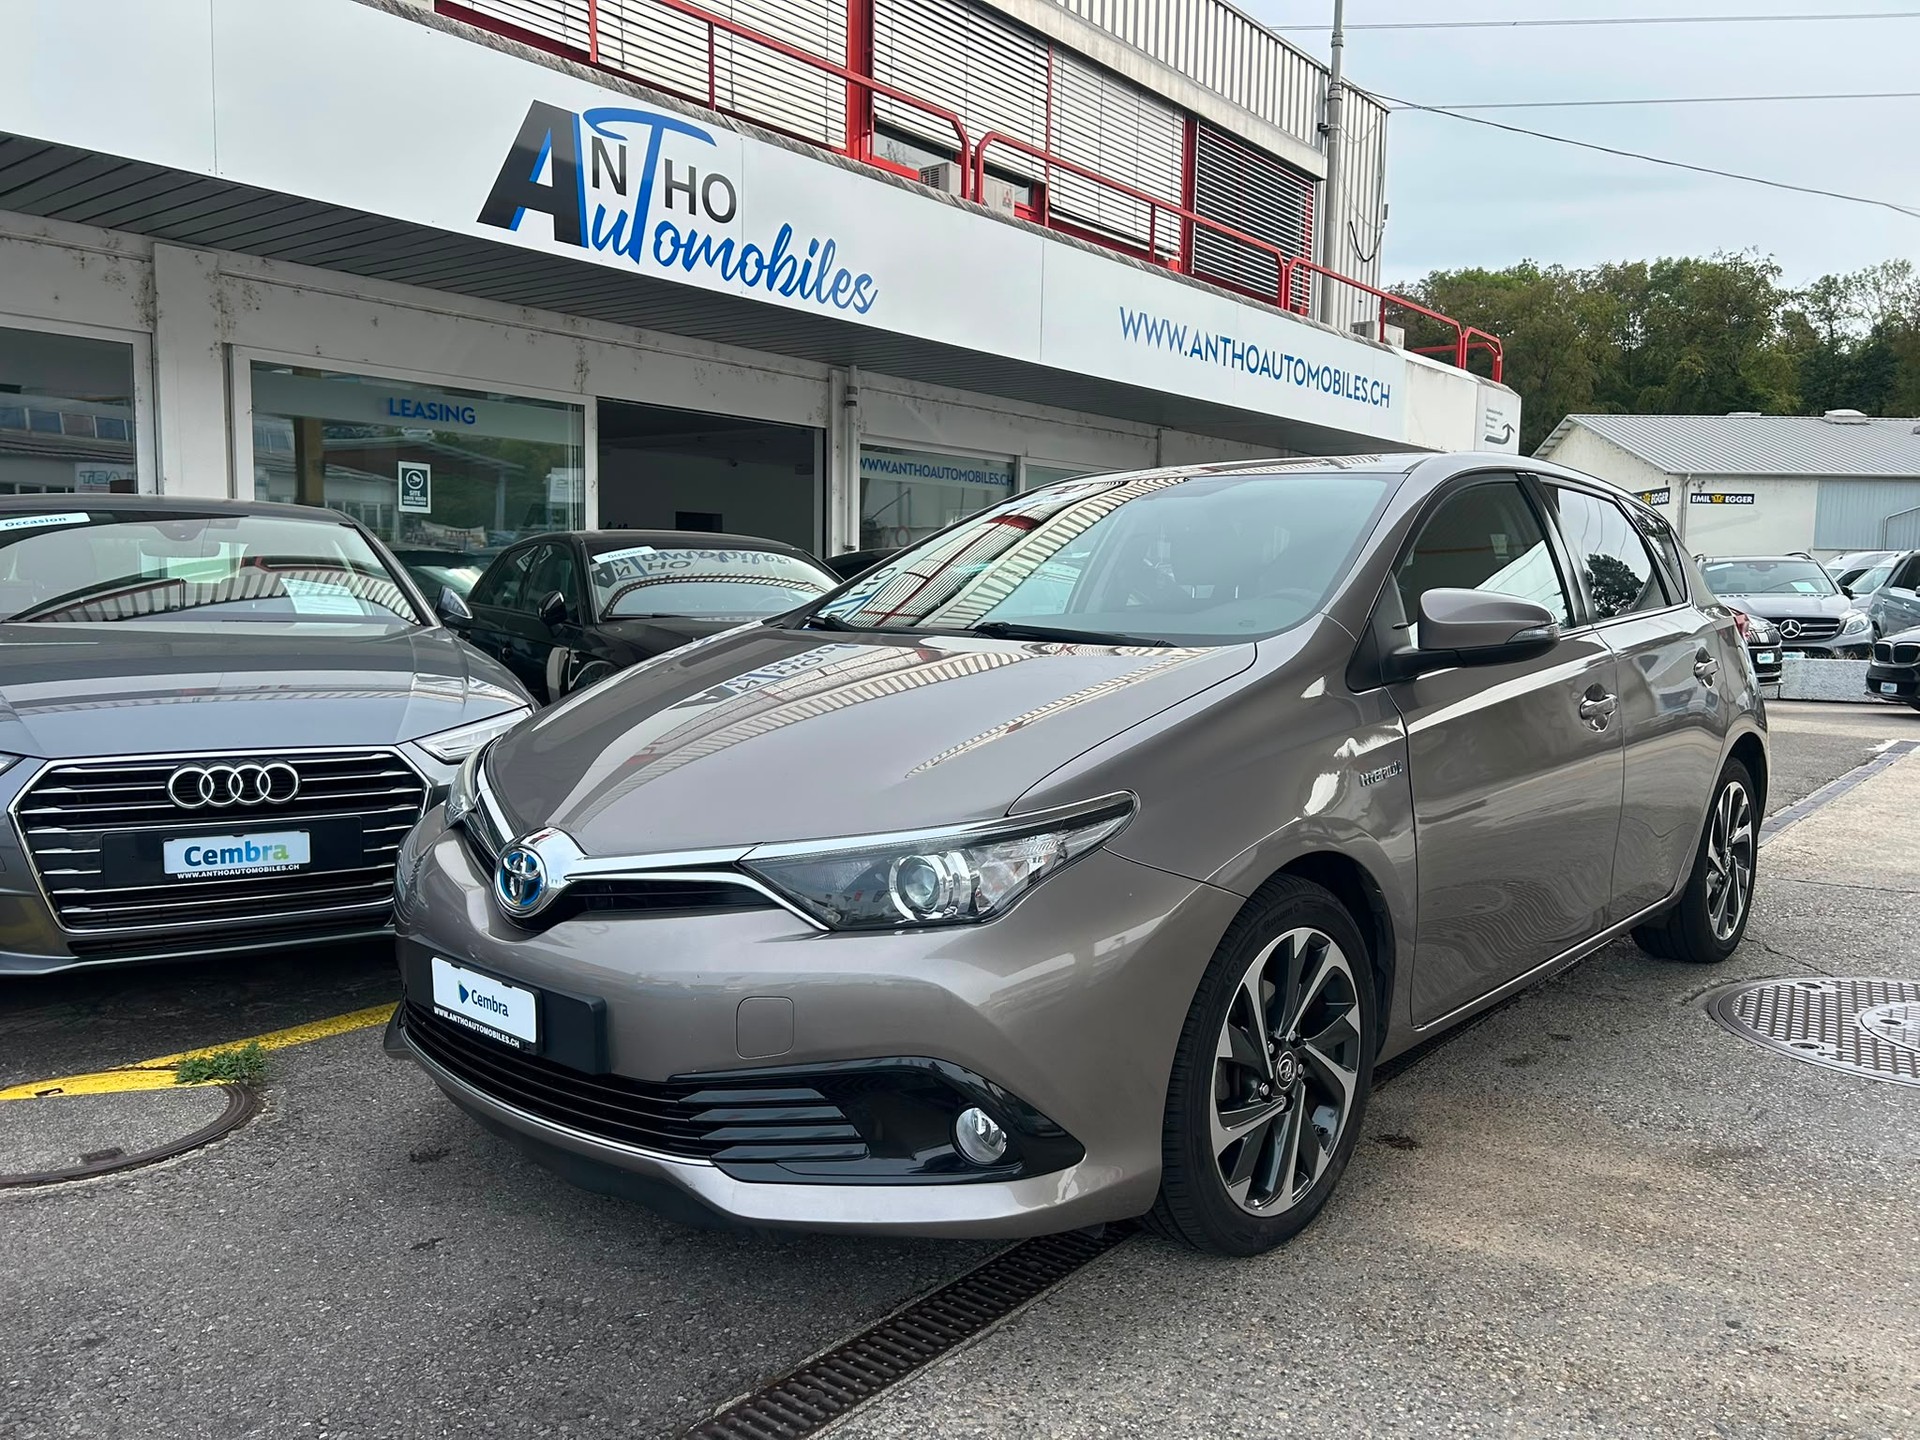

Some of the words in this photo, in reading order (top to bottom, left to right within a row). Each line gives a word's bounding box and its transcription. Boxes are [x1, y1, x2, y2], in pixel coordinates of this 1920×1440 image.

[1119, 306, 1391, 409] WWW.ANTHOAUTOMOBILES.CH
[389, 397, 476, 425] LEASING
[1651, 491, 1669, 504] EGGER
[1692, 495, 1711, 503] EMIL
[1725, 495, 1753, 504] EGGER
[5, 516, 67, 527] Occasion
[184, 840, 290, 867] Cembra
[177, 864, 300, 880] WWW.ANTHOAUTOMOBILES.CH
[471, 989, 509, 1018] Cembra
[433, 1006, 520, 1049] WWW.ANTHOAUTOMOBILES.CH
